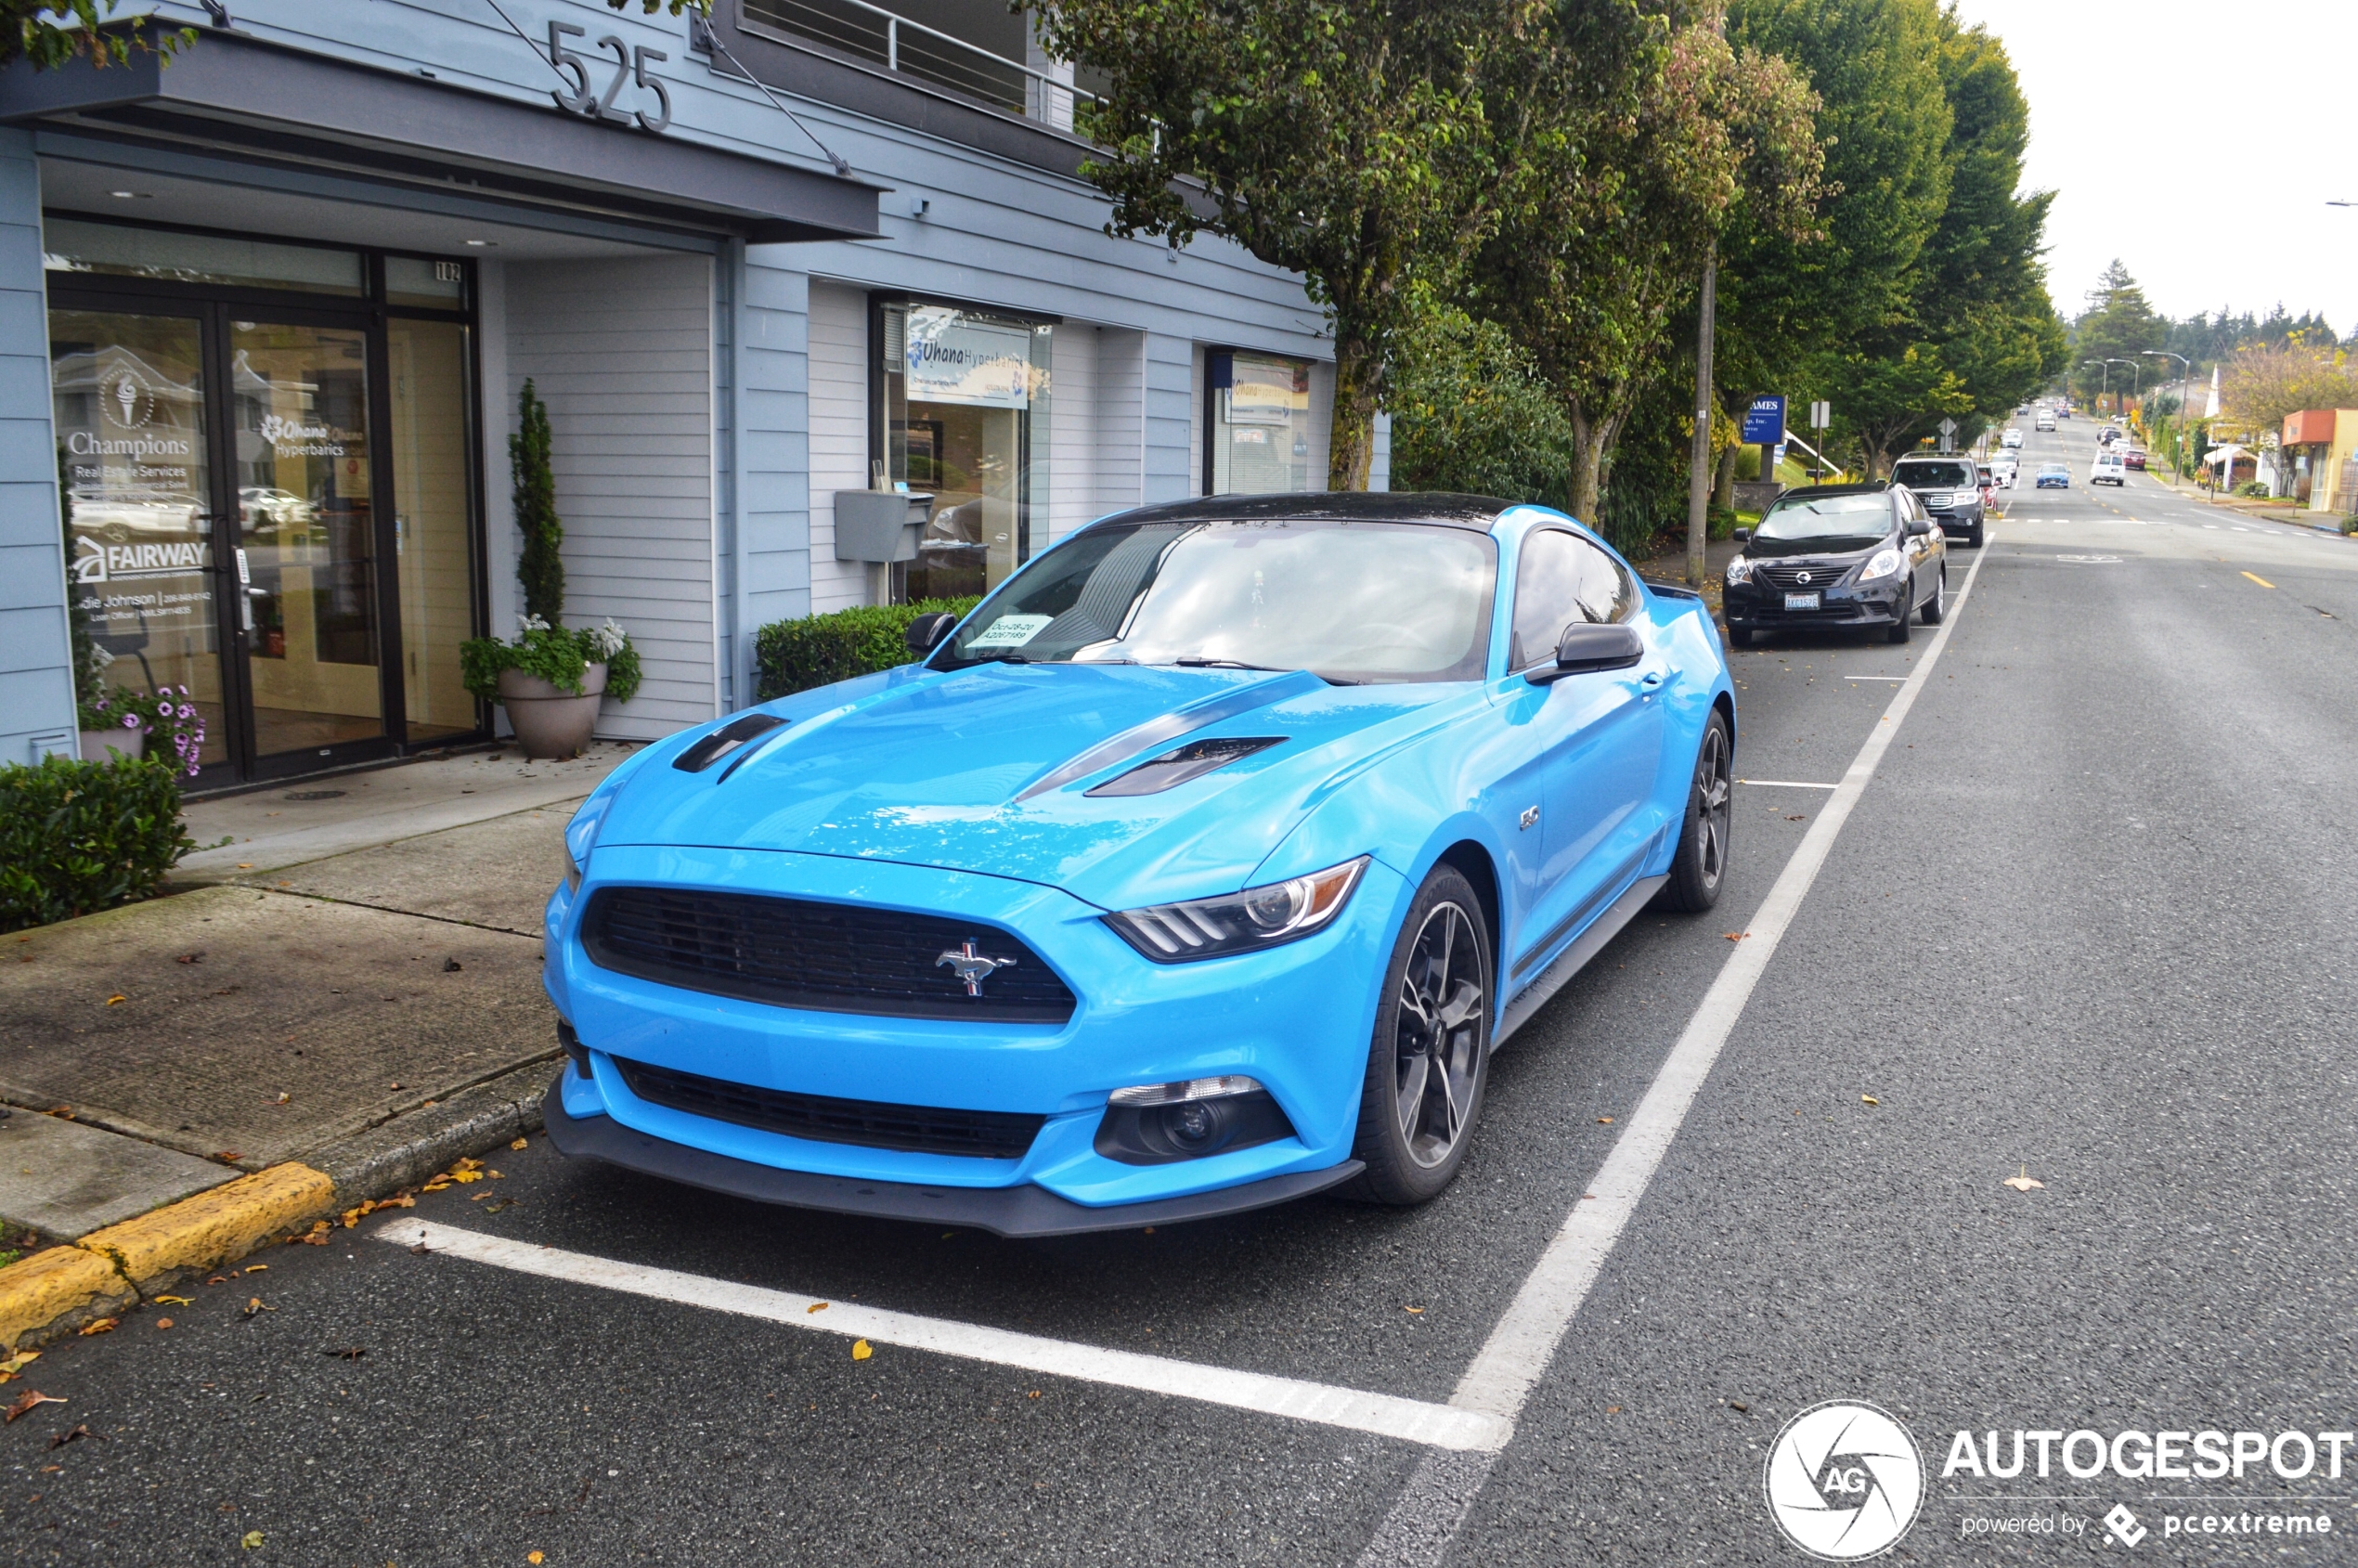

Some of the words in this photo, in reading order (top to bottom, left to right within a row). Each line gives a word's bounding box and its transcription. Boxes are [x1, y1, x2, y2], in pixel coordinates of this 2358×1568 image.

[548, 20, 671, 132] 525
[438, 262, 460, 281] 102
[965, 349, 1024, 369] Hyperbarics
[1750, 400, 1778, 410] AMES
[283, 421, 328, 442] Ohana
[69, 432, 189, 461] Champions
[276, 443, 344, 458] Hyperbarics
[75, 466, 101, 477] Real
[102, 465, 138, 477] Estate
[138, 465, 187, 477] Services
[108, 542, 207, 570] FAIRWAY
[103, 593, 156, 608] Johnson
[90, 614, 110, 622] Loan
